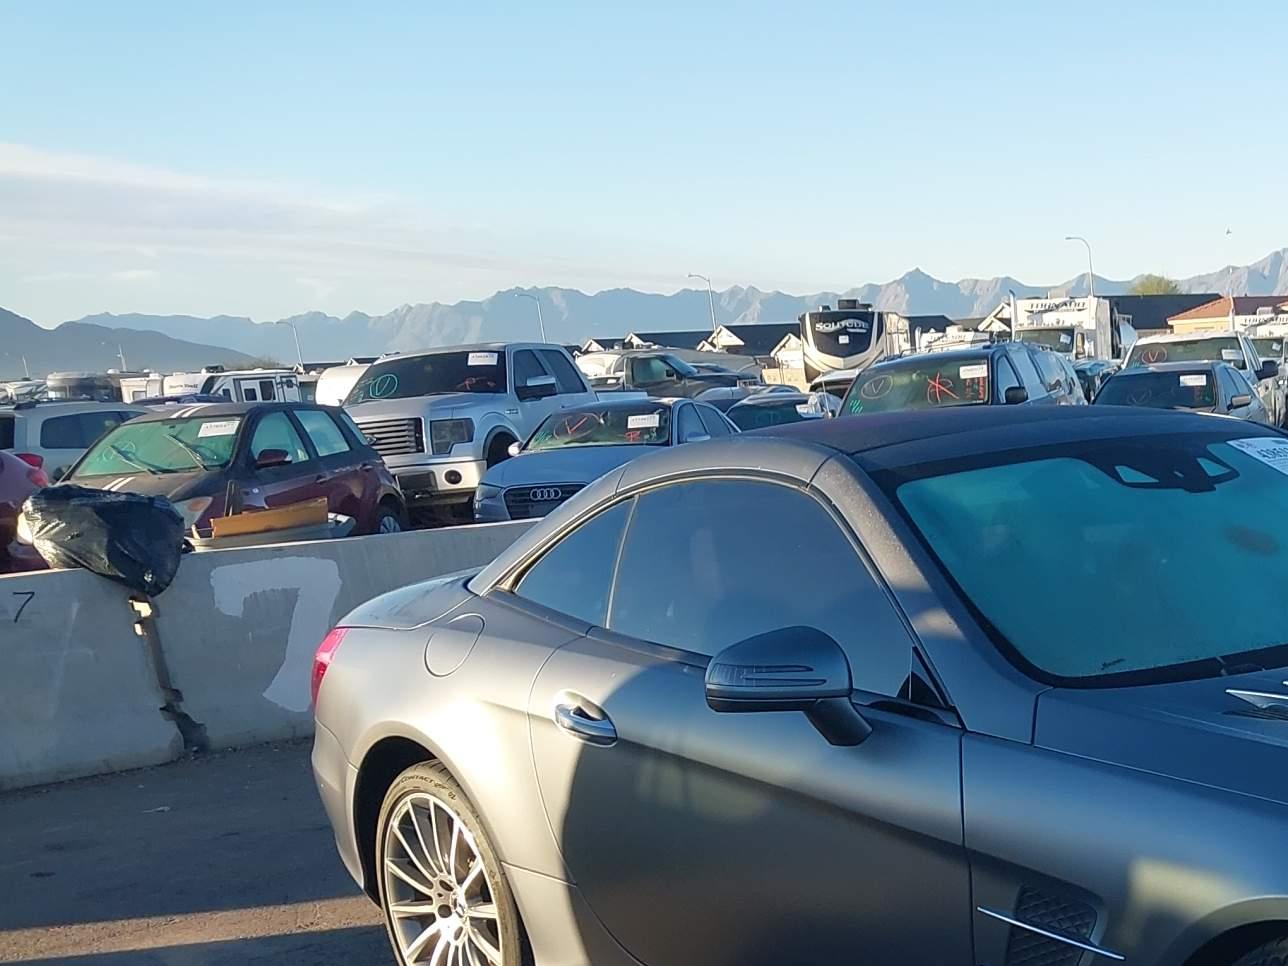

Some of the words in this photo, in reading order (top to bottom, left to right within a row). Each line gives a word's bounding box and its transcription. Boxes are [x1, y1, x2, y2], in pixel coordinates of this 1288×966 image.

[815, 319, 869, 331] SOLITUDE
[13, 591, 35, 623] 7
[210, 556, 342, 712] 7
